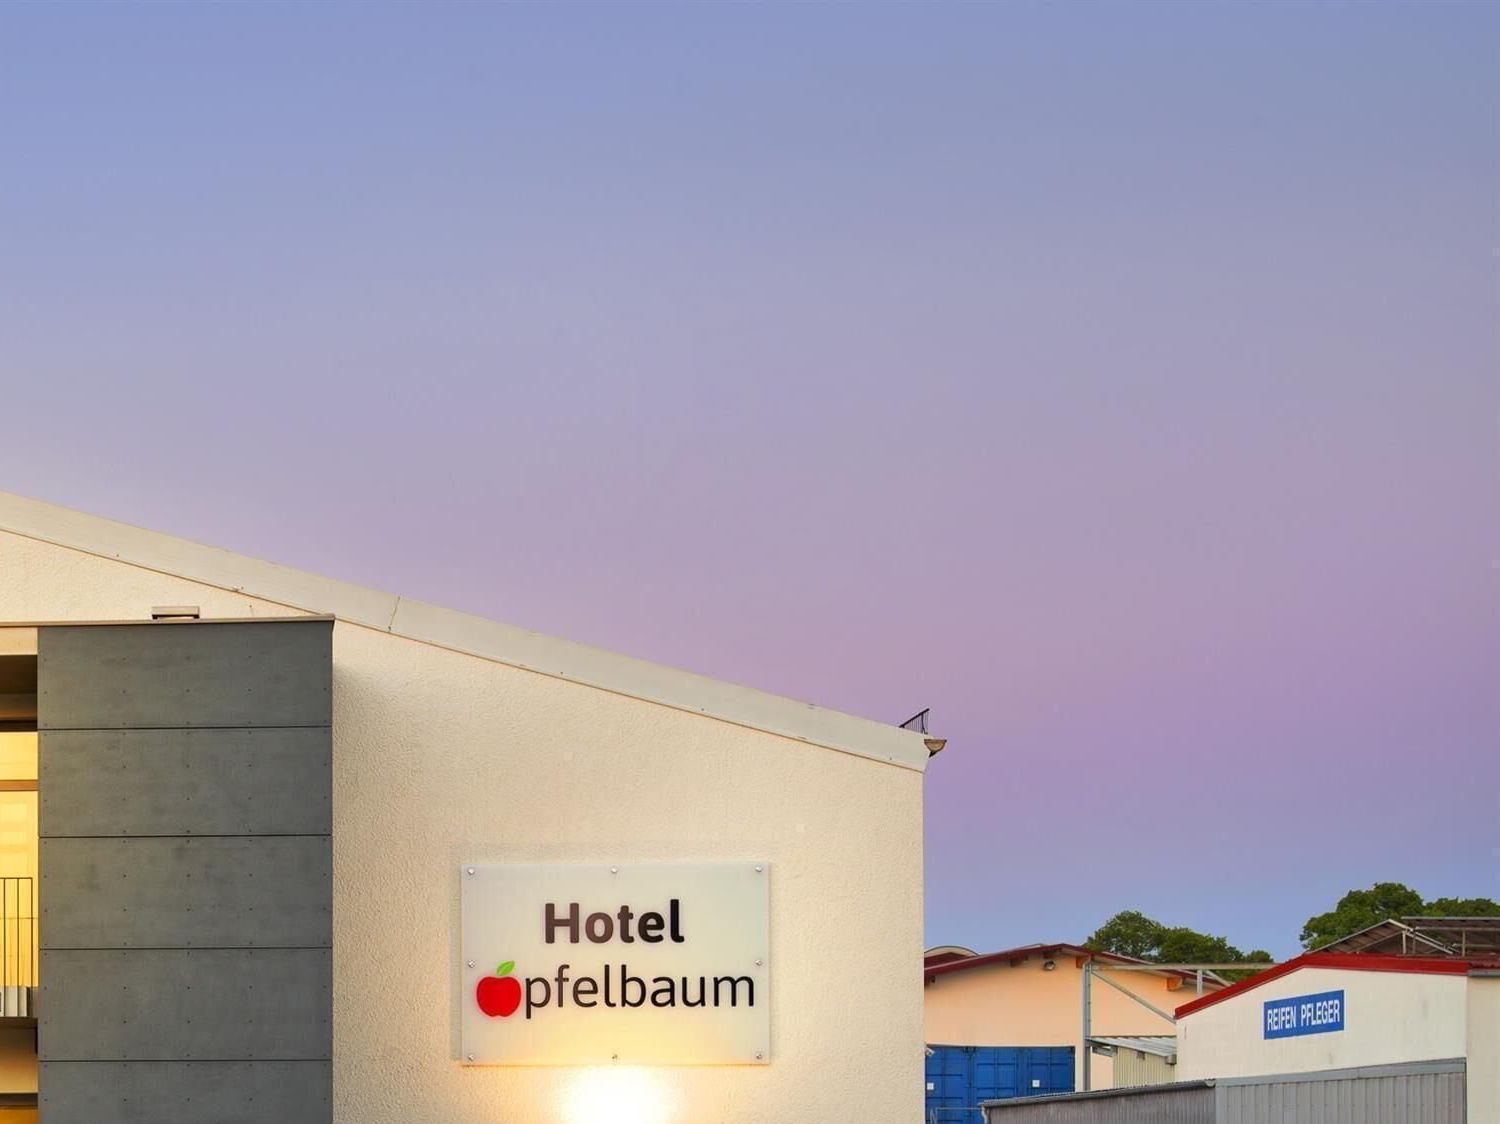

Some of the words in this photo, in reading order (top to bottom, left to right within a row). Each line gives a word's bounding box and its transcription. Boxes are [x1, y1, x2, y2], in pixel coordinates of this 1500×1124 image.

[544, 899, 685, 944] Hotel
[525, 964, 756, 1020] pfelbaum
[1267, 1005, 1297, 1031] REIFEN
[1300, 999, 1341, 1027] PFLEGER
